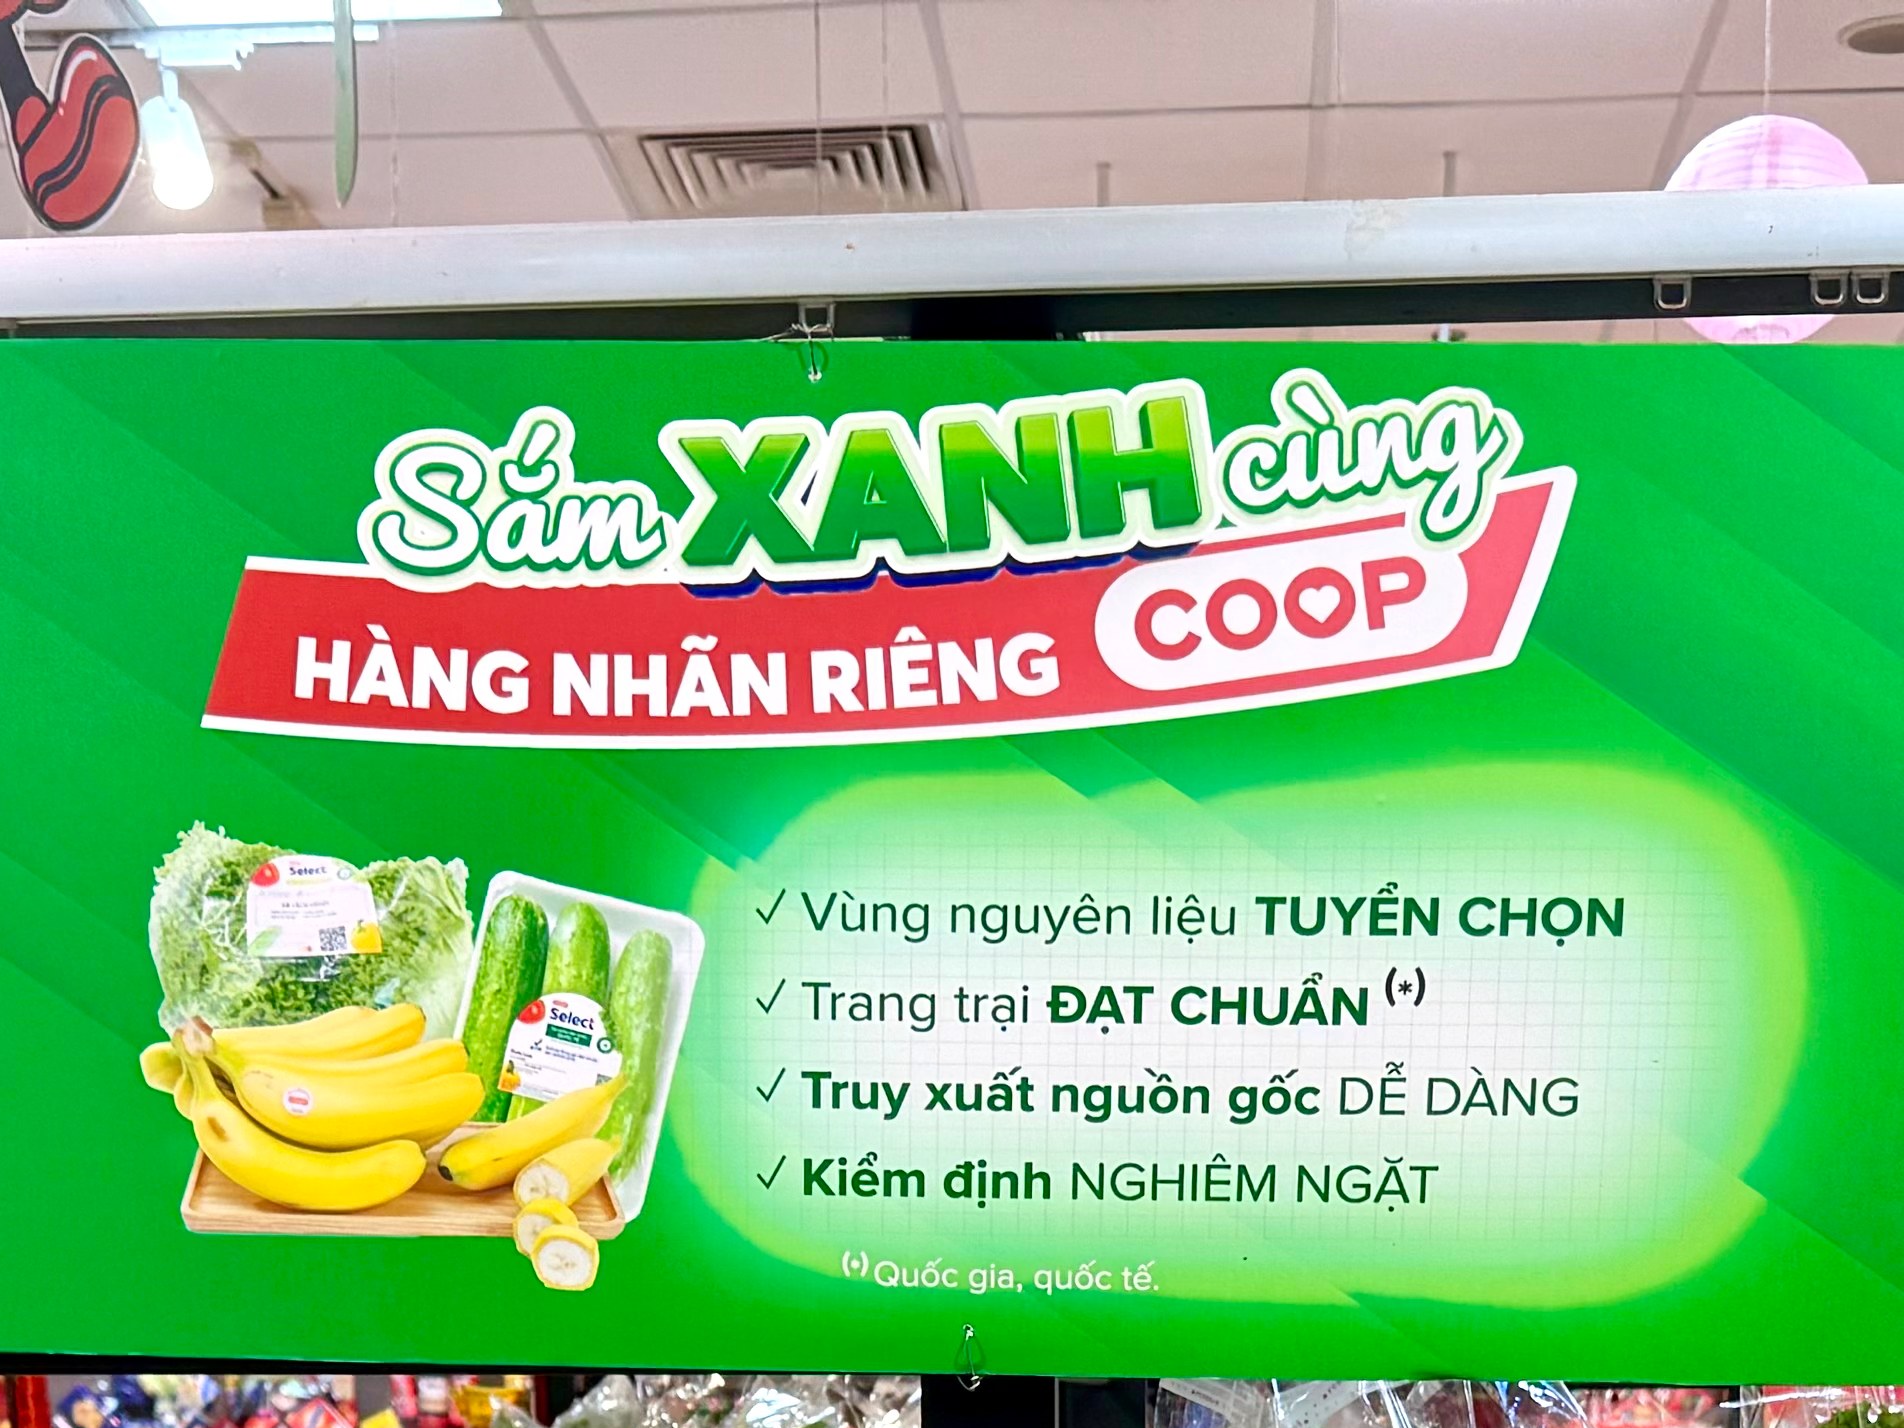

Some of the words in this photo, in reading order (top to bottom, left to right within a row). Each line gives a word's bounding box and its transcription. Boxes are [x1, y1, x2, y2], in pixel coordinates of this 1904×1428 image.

[375, 412, 666, 578] Sắm
[679, 395, 1204, 585] XANH
[1222, 378, 1508, 545] cùng
[294, 622, 532, 714] HÀNG
[552, 630, 788, 720] NHÃN
[812, 628, 1059, 715] RIÊNG
[1132, 552, 1430, 664] COOP
[800, 891, 931, 944] Vùng
[950, 894, 1132, 944] nguyên
[1151, 890, 1238, 940] liệu
[1255, 881, 1440, 938] TUYỂN
[1457, 894, 1626, 948] CHỌN
[550, 1008, 594, 1030] Select
[801, 980, 938, 1033] Trang
[954, 983, 1031, 1031] trại
[1046, 986, 1155, 1036] ĐẠT
[1170, 971, 1369, 1027] CHUẨN
[801, 1070, 910, 1121] Truy
[924, 1065, 1035, 1114] xuất
[1049, 1067, 1211, 1121] nguồn
[1228, 1067, 1322, 1121] gốc
[1339, 1060, 1408, 1117] DỄ
[1426, 1066, 1580, 1118] DÀNG
[801, 1148, 926, 1199] Kiểm
[943, 1157, 1053, 1210] định
[1071, 1154, 1277, 1203] NGHIÊM
[1296, 1156, 1439, 1214] NGẶT
[873, 1253, 961, 1289] Quốc
[969, 1260, 1024, 1294] gia,
[1033, 1253, 1115, 1294] quốc
[1122, 1252, 1162, 1291] tế.
